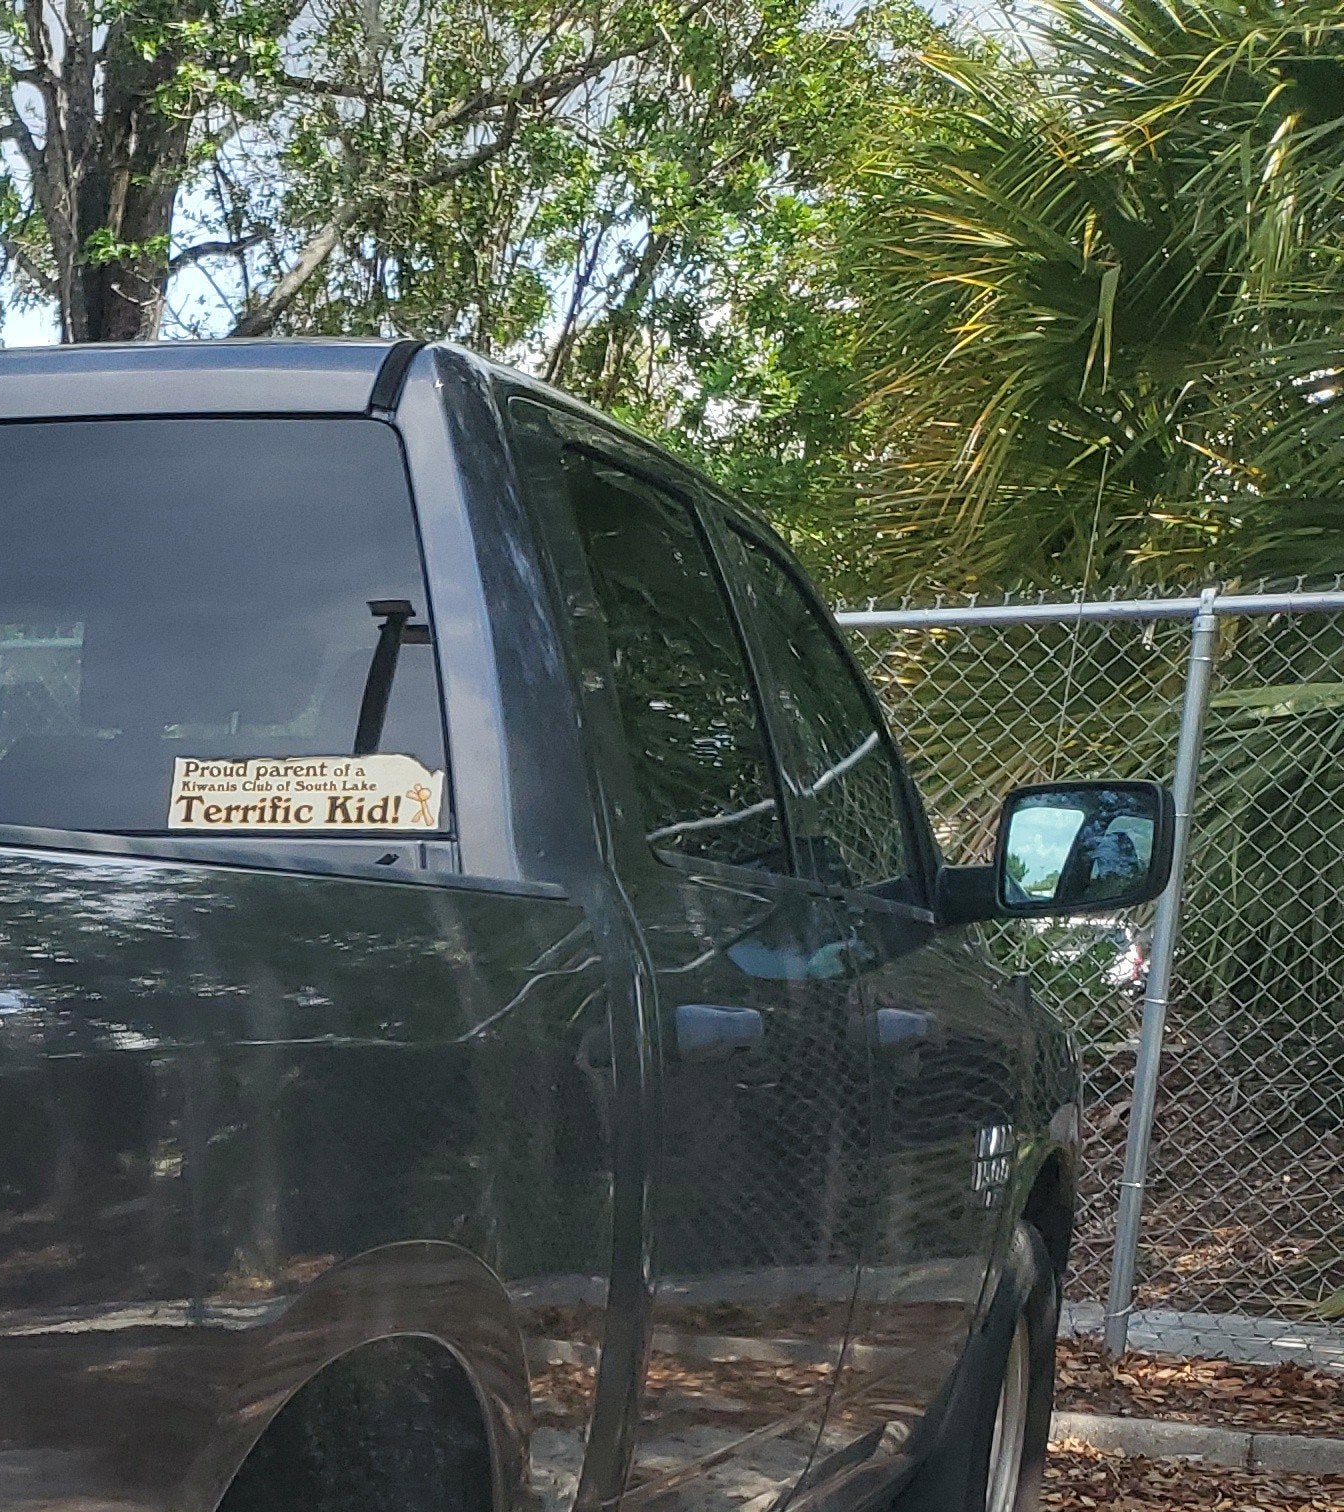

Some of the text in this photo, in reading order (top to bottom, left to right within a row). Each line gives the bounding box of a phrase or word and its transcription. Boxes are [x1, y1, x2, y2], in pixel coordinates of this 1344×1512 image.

[183, 761, 366, 781] Proud parent of a
[181, 780, 377, 792] Kiwanis Club of South Lake
[176, 795, 402, 824] Terrific Kid!
